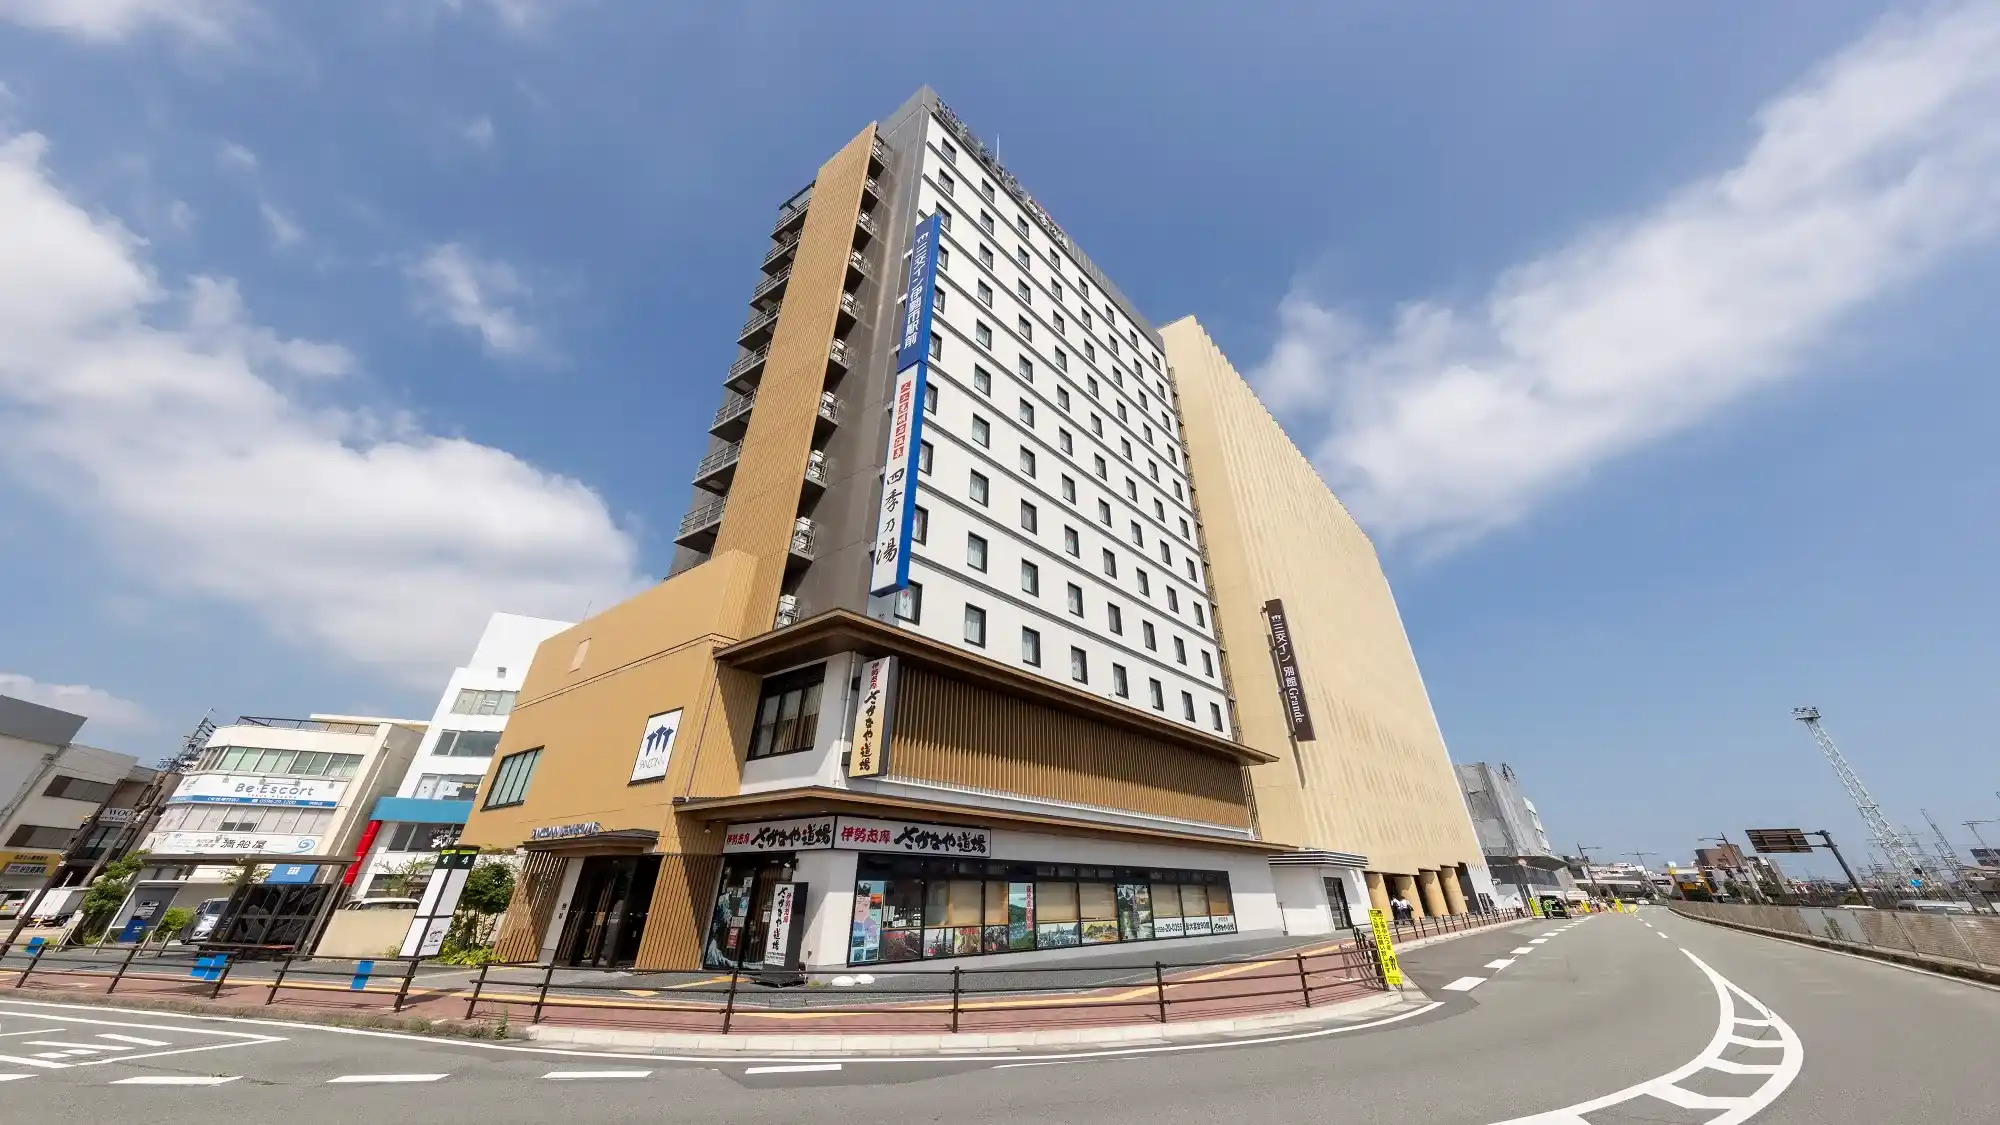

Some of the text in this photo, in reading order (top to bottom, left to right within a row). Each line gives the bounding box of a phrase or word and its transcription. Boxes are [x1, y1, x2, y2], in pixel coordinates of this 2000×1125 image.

[876, 467, 904, 565] 四季乃湯
[751, 823, 832, 847] さかなや道場
[841, 825, 987, 853] 伊勢志摩 さかなや道場
[442, 856, 449, 865] 4
[461, 856, 469, 865] 4
